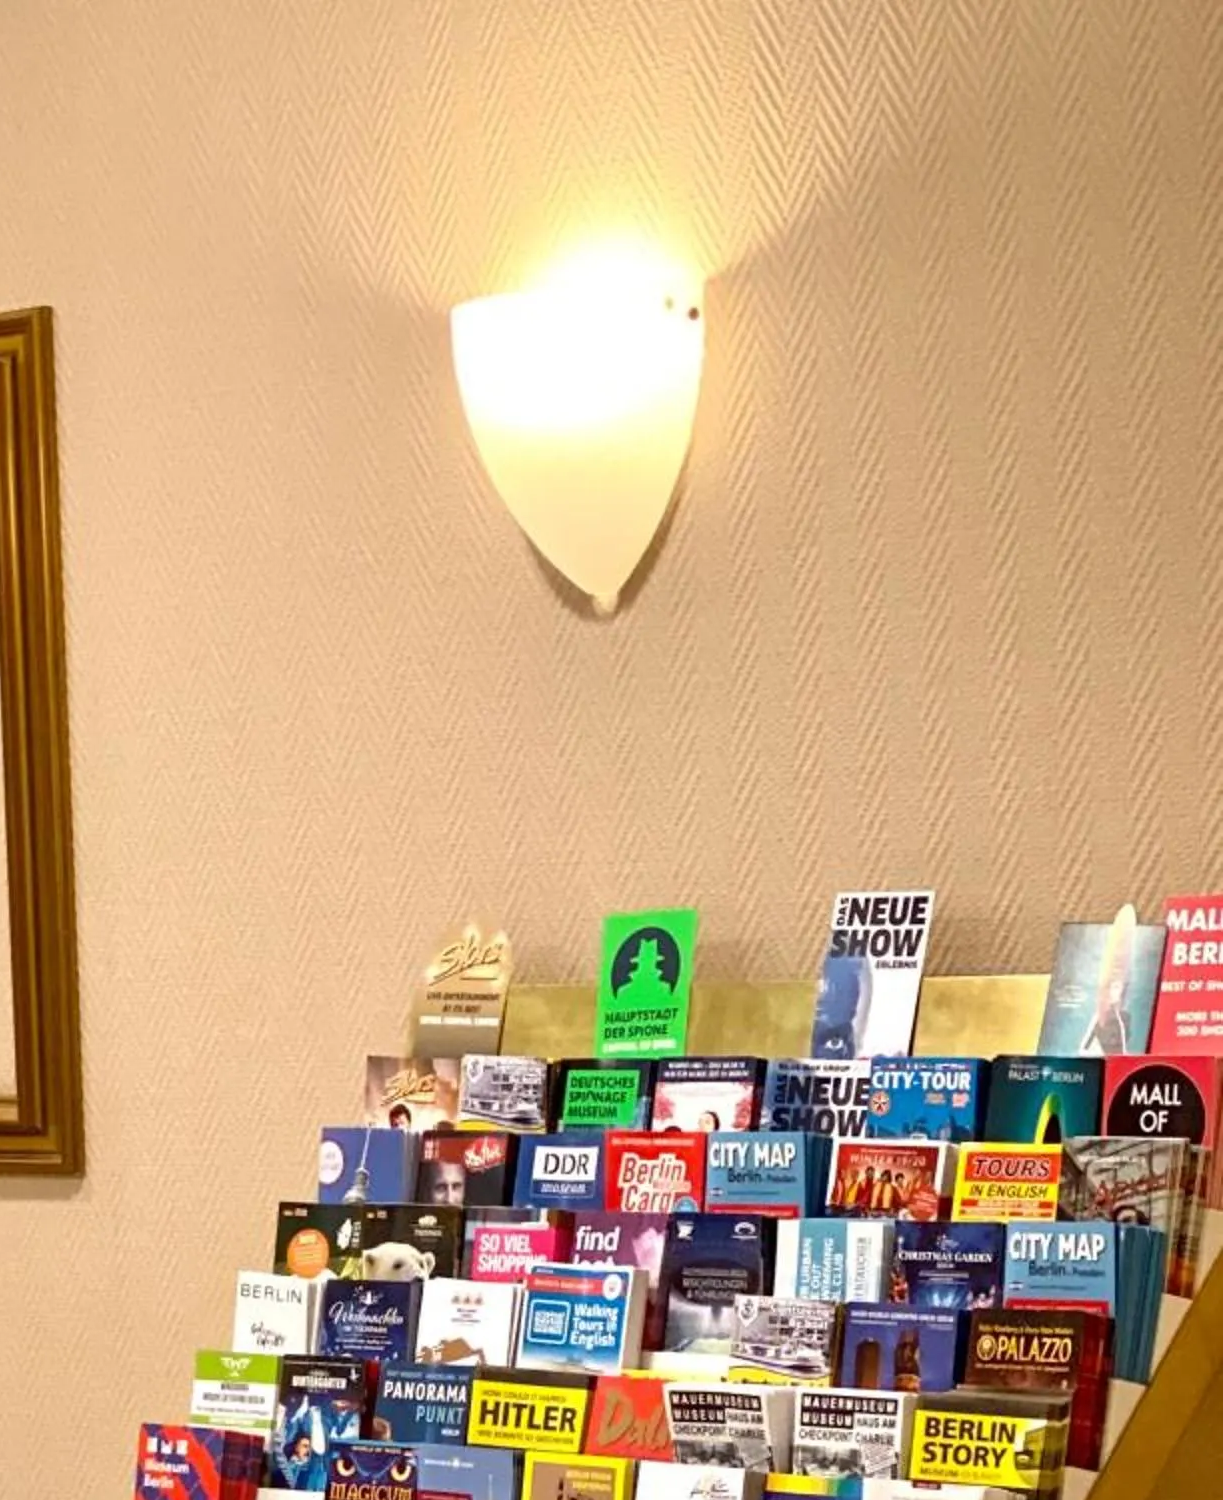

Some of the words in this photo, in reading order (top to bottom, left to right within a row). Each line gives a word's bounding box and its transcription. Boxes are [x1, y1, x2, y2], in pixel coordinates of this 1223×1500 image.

[848, 896, 930, 926] NEUE
[830, 928, 924, 958] SHOW
[604, 1008, 679, 1024] HAUPTSTADT
[604, 1026, 626, 1039] DER
[628, 1024, 668, 1037] SPIONE
[570, 1076, 635, 1090] DEUTSCHES
[872, 1071, 971, 1090] CITY-TOUR
[570, 1090, 627, 1103] SPIONAGE
[785, 1075, 870, 1106] NEUE
[1129, 1083, 1183, 1107] MALL
[568, 1104, 618, 1118] MUSEUM
[770, 1107, 867, 1138] SHOW
[1139, 1110, 1169, 1133] OF
[542, 1153, 591, 1176] DDR
[709, 1141, 752, 1168] CITY
[754, 1143, 797, 1170] MAP
[622, 1154, 684, 1184] Berlin
[728, 1169, 762, 1184] Berlin
[973, 1157, 1051, 1178] TOURS
[969, 1184, 985, 1197] IN
[986, 1184, 1050, 1199] ENGLISH
[480, 1233, 501, 1250] SO
[503, 1234, 532, 1252] VIEL
[575, 1226, 621, 1252] find
[1009, 1232, 1053, 1260] CITY
[1057, 1233, 1106, 1262] MAP
[954, 1252, 993, 1264] GARDEN
[1028, 1261, 1067, 1277] Berlin
[240, 1283, 303, 1305] BERLIN
[574, 1303, 619, 1321] Walking
[573, 1317, 604, 1331] Tours
[570, 1331, 616, 1350] English
[996, 1335, 1073, 1363] PALAZZO
[383, 1380, 467, 1403] PANORAMA
[671, 1393, 760, 1410] MAUERMUSEUM
[803, 1393, 897, 1412] MAUERMUSEUM
[415, 1405, 464, 1425] PUNKT
[479, 1399, 577, 1433] HITLER
[672, 1409, 726, 1423] MUSEUM
[802, 1412, 853, 1427] MUSEUM
[673, 1424, 726, 1437] CHECKPOINT
[799, 1428, 853, 1442] CHECKPOINT
[855, 1432, 895, 1446] CHARLIE
[924, 1416, 1017, 1444] BERLIN
[922, 1442, 1007, 1468] STORY
